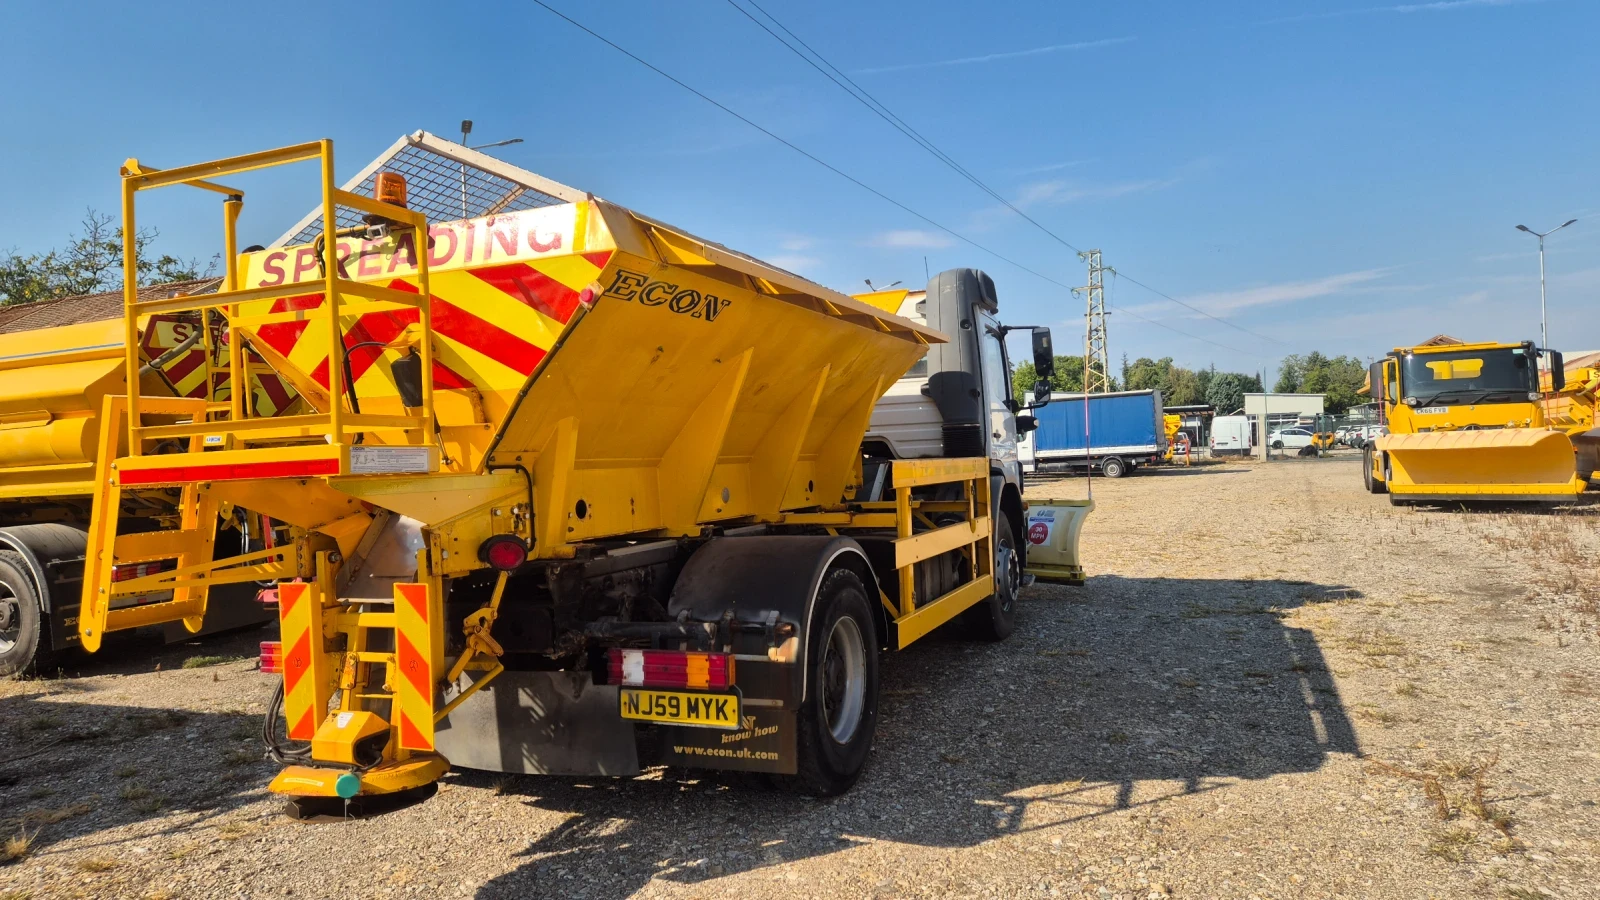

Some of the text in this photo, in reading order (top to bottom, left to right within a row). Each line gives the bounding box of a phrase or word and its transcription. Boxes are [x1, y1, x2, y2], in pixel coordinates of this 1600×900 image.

[258, 216, 563, 288] SPREADING
[603, 268, 732, 322] ECON
[627, 693, 729, 721] NJ59 MYK
[721, 725, 779, 744] know how
[673, 745, 779, 760] www.econ.uk.com
